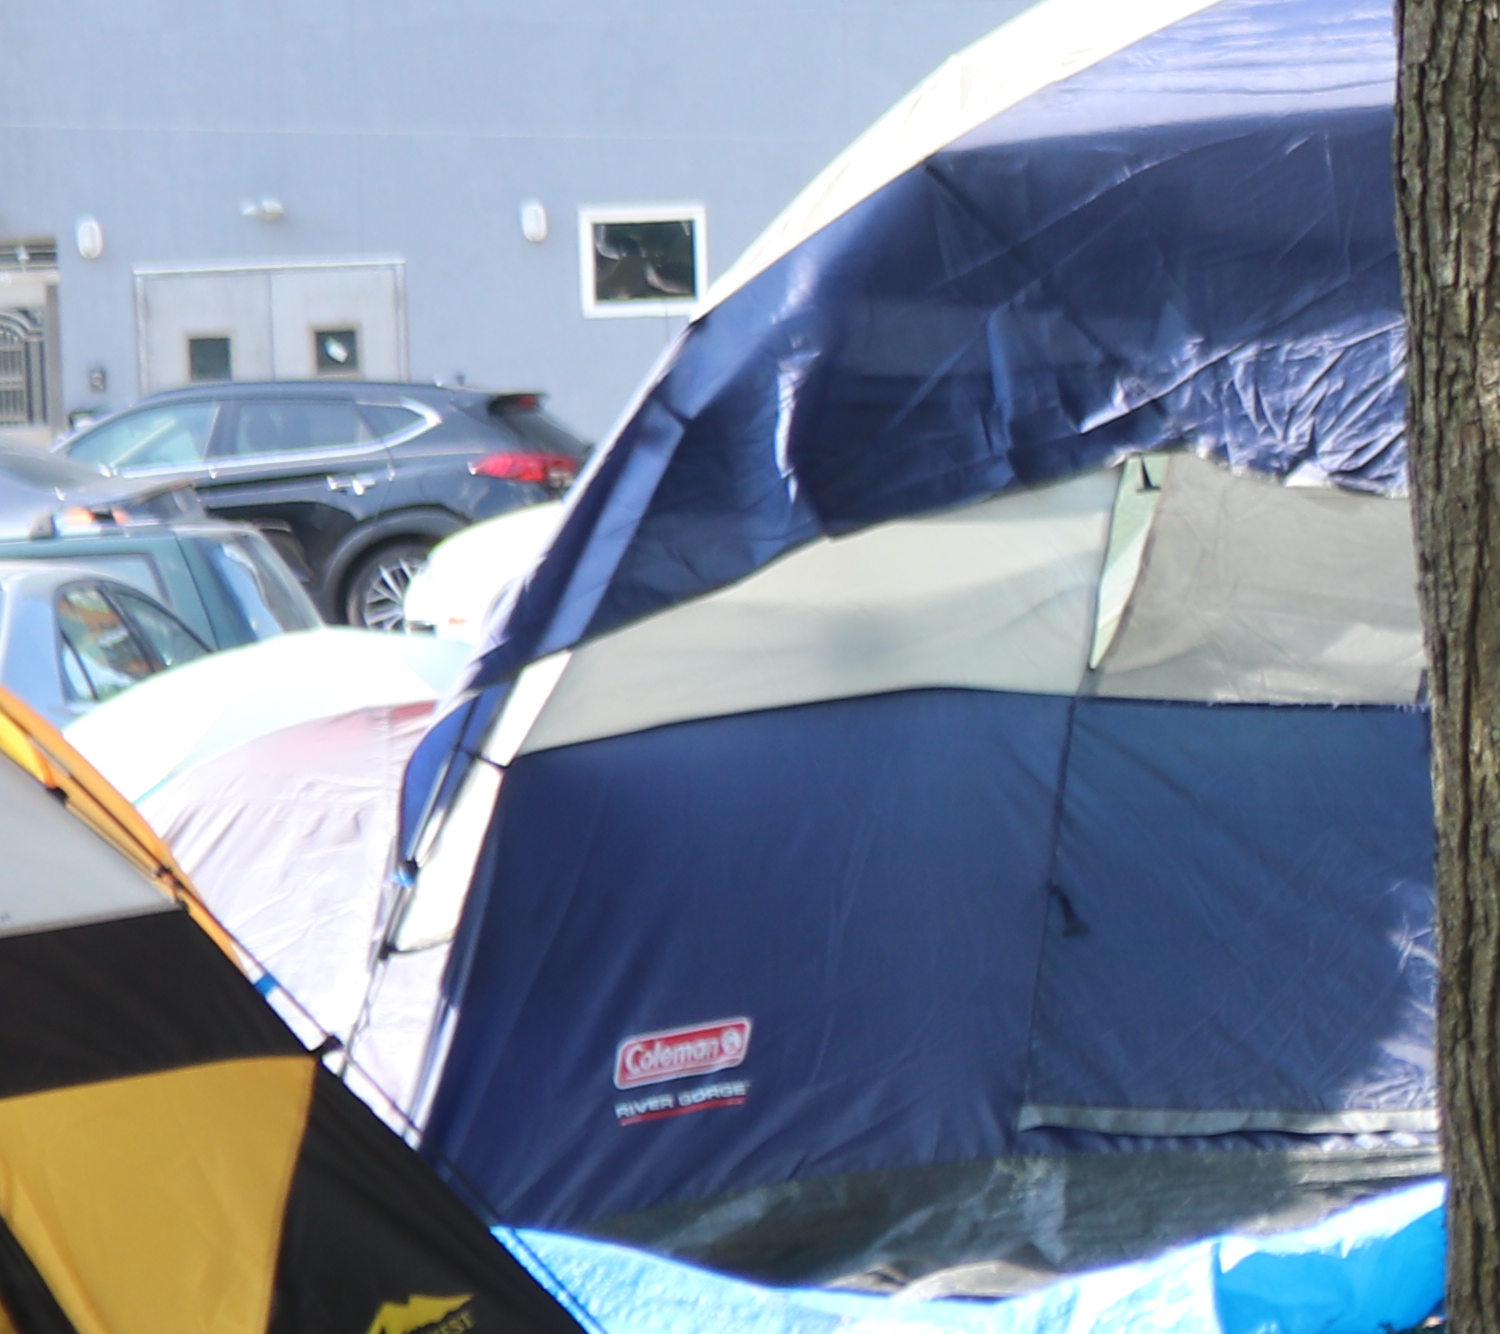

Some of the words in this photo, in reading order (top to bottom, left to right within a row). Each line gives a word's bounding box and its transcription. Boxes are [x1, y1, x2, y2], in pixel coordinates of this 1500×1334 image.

[624, 1037, 719, 1075] Coleman
[614, 1093, 675, 1119] RIVER
[678, 1082, 748, 1107] GORGE
